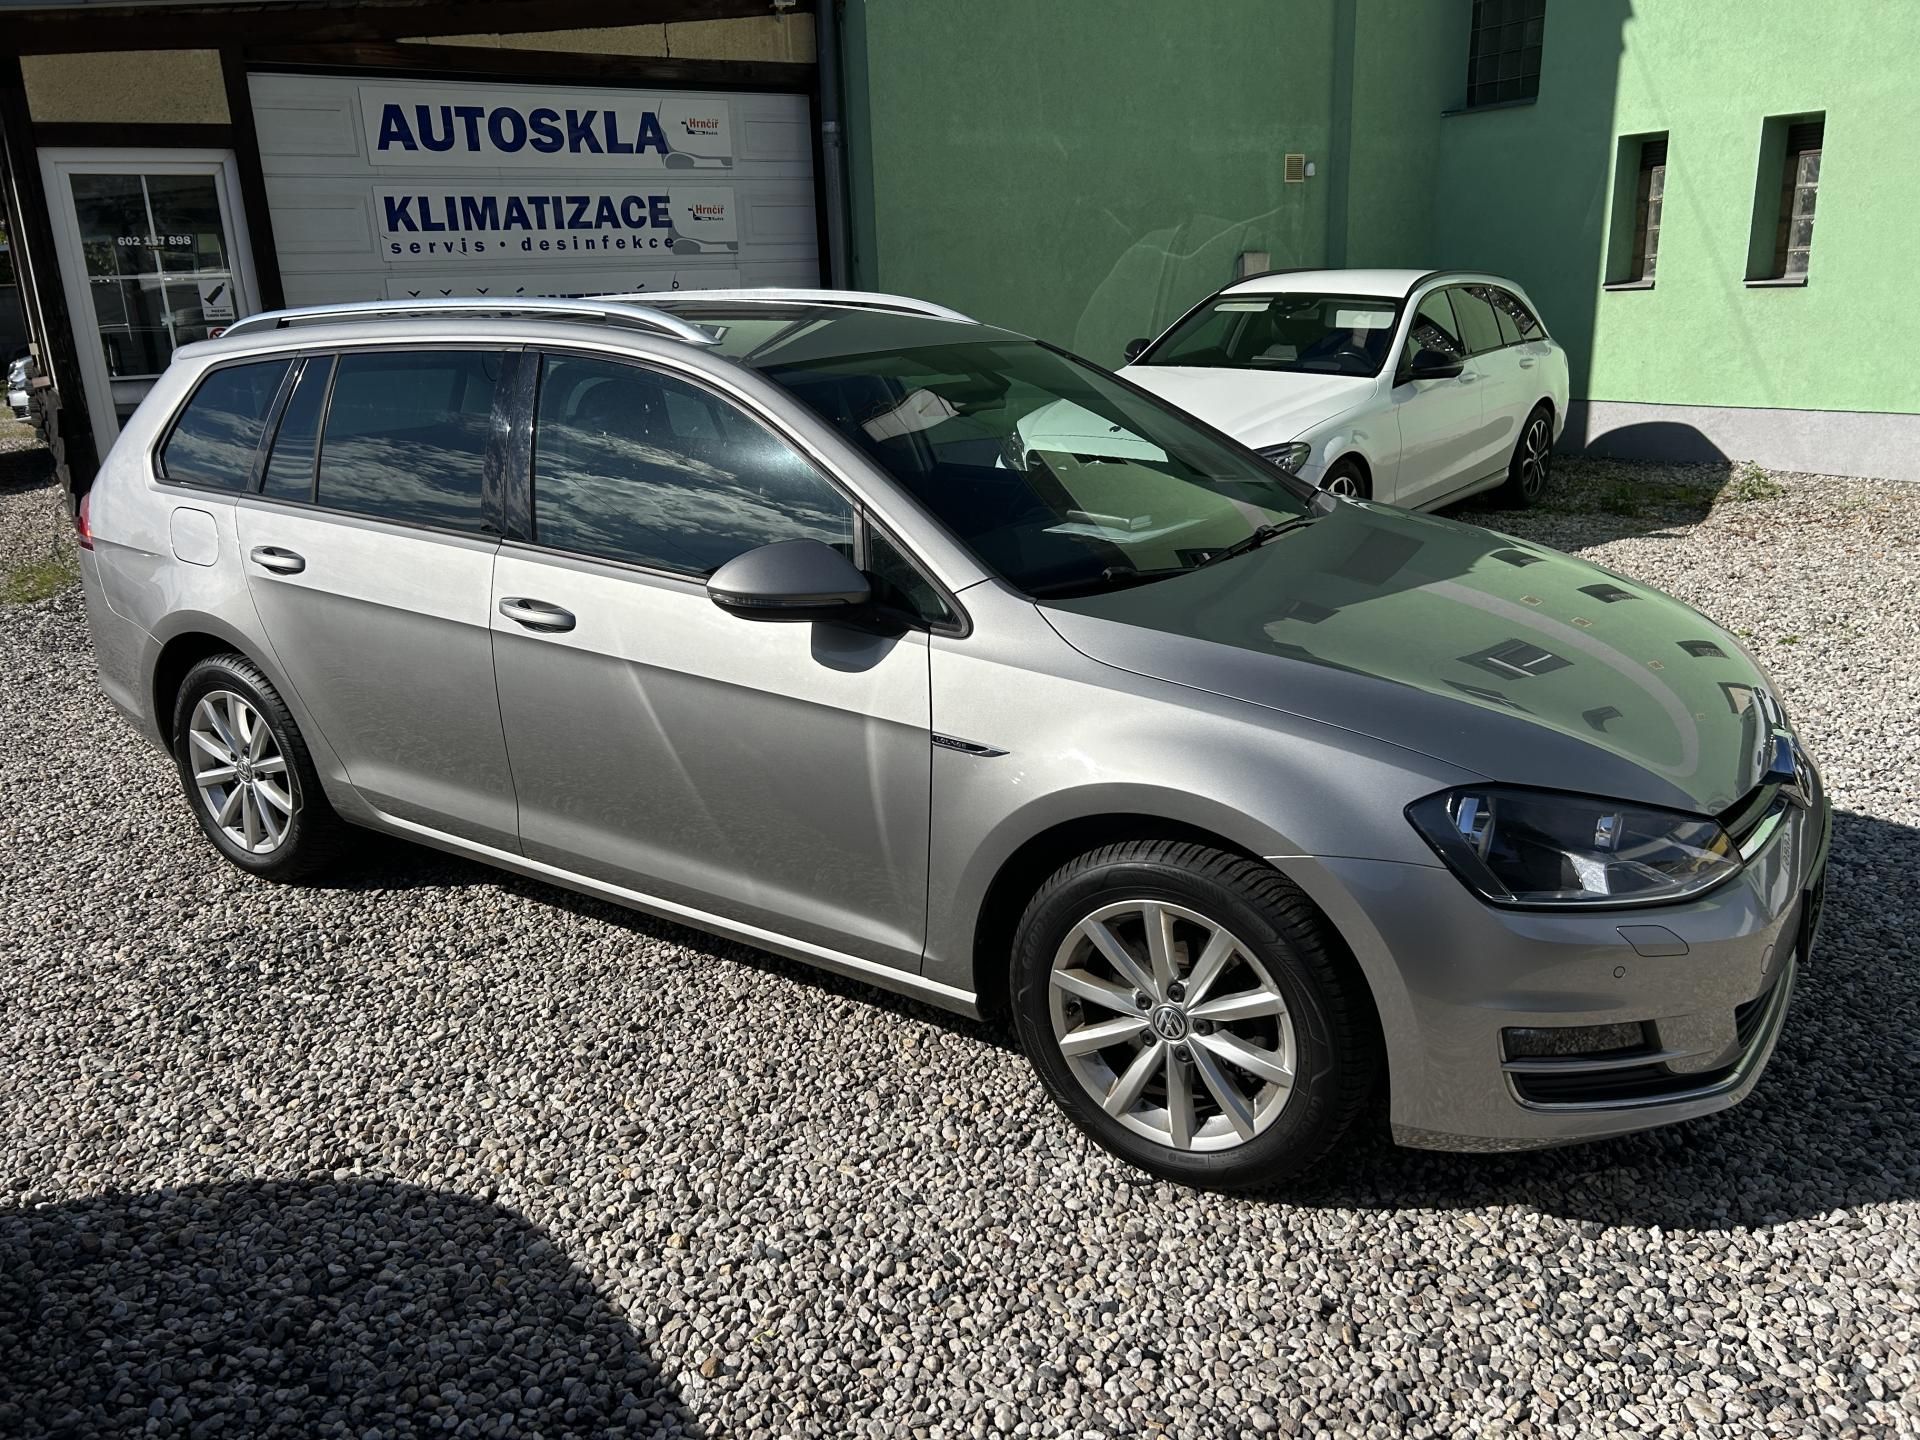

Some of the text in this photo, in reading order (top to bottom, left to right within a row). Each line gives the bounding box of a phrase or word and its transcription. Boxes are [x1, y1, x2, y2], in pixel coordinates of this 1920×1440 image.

[377, 103, 669, 154] AUTOSKLA
[383, 195, 673, 232] KLIMATIZACE
[118, 236, 141, 246] 602
[168, 235, 191, 245] 898
[391, 235, 674, 254] servis desinfekce
